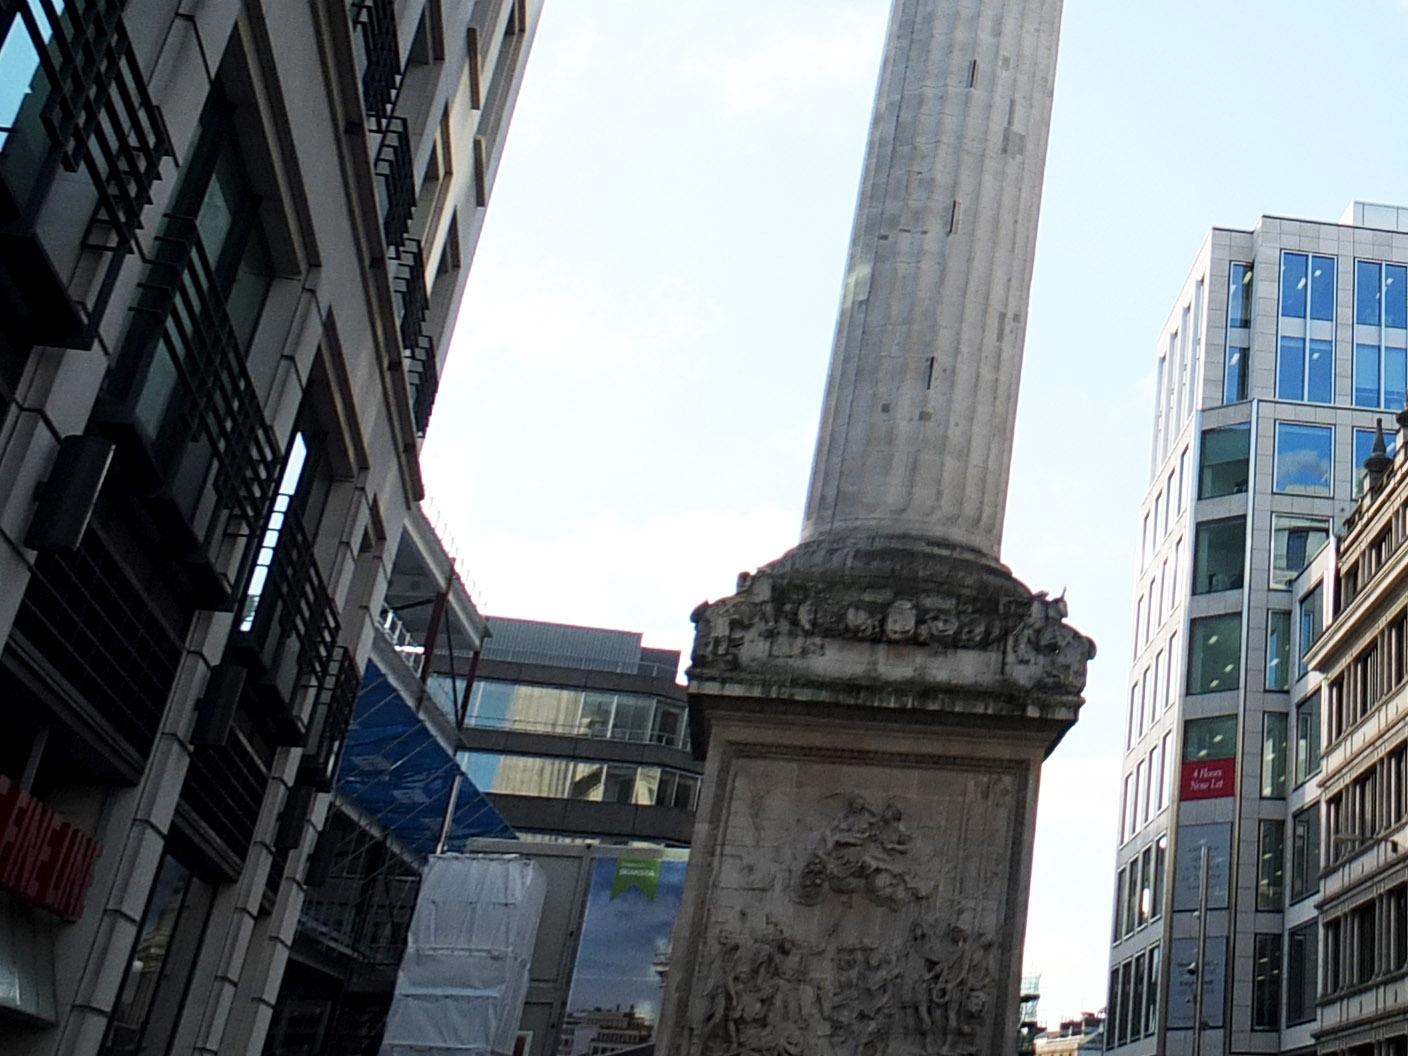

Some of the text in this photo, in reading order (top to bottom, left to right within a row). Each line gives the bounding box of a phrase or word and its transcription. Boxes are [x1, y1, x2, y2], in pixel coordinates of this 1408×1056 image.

[1199, 767, 1222, 779] Floors
[1190, 778, 1223, 790] Now Let
